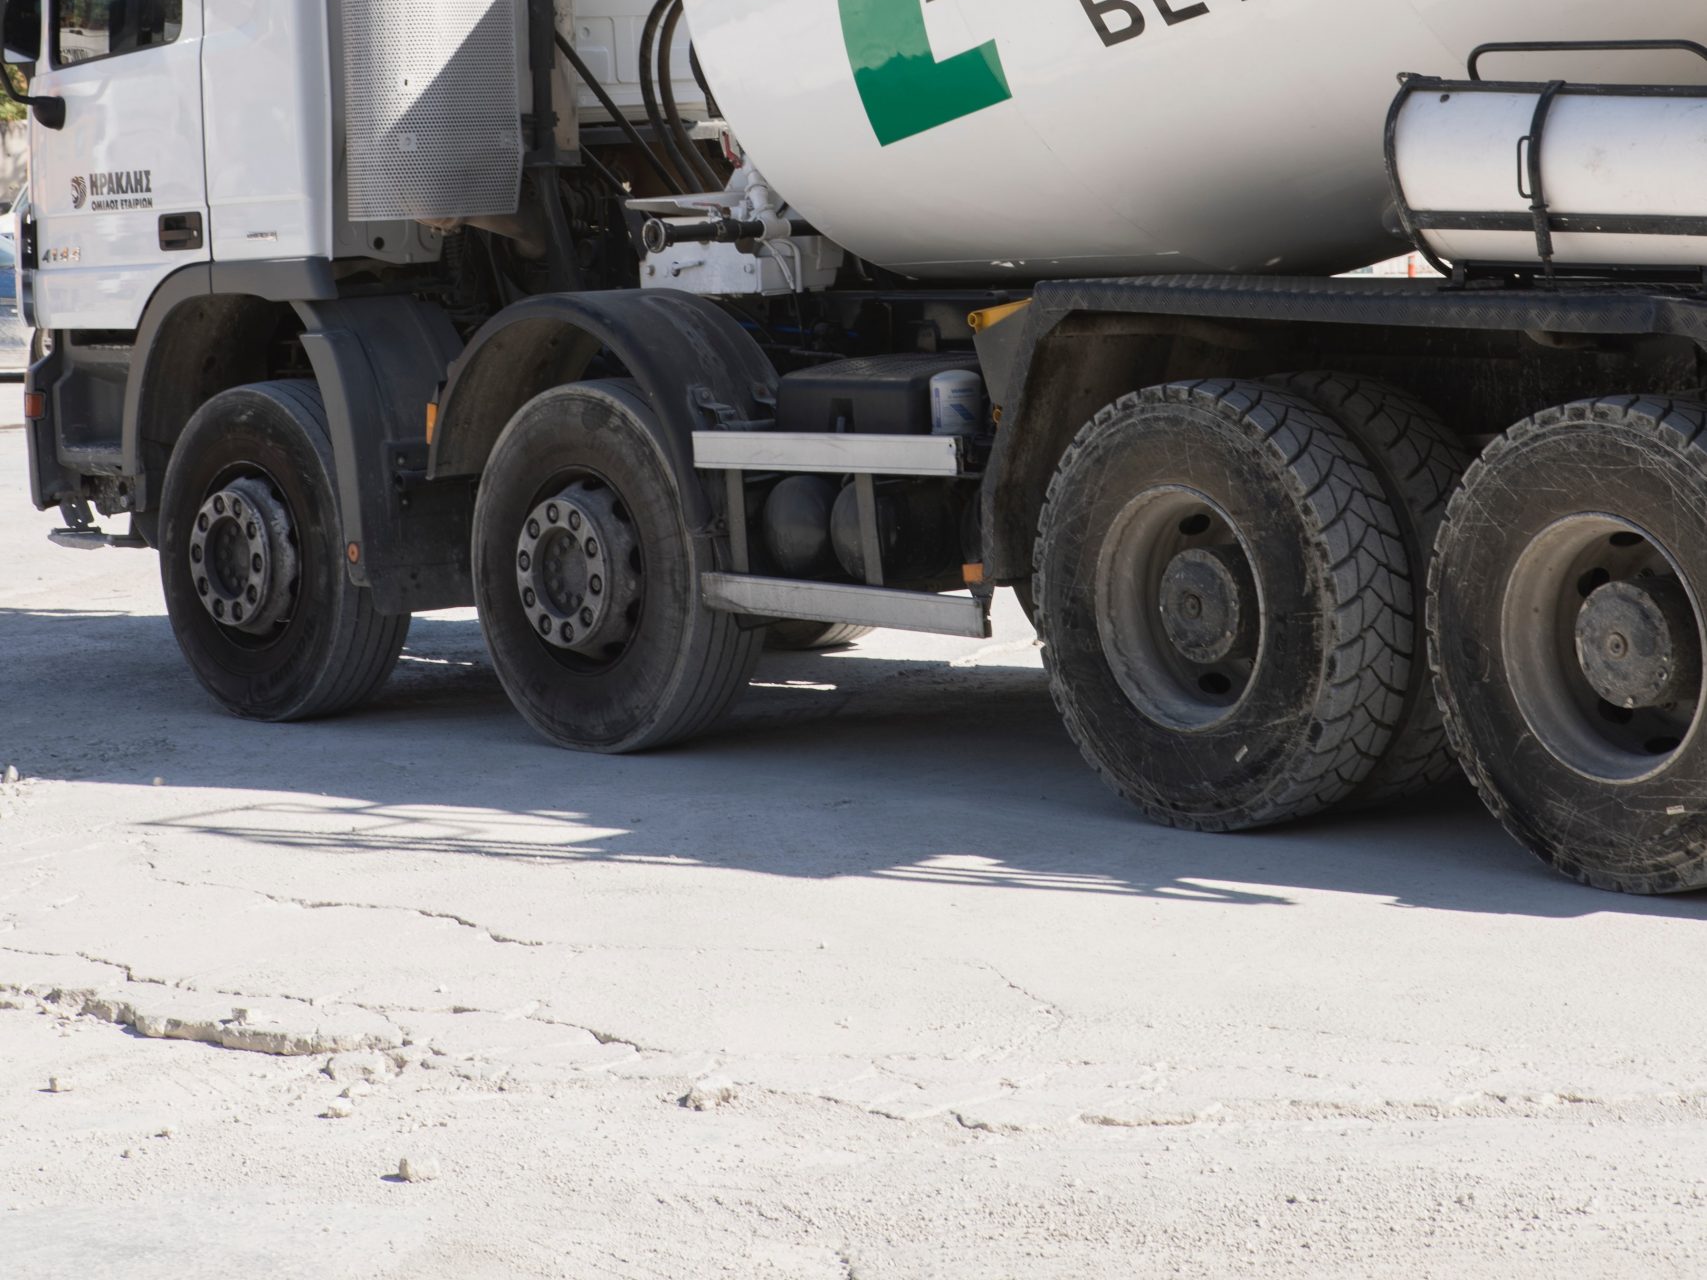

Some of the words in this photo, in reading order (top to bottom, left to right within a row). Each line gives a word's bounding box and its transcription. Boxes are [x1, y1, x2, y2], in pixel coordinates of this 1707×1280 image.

[89, 170, 152, 196] ΗΡΑΚΛΗΣ
[91, 199, 119, 211] ΟΜΙΛΟΣ
[120, 197, 153, 210] ΕΤΑΙΡΙΩΝ
